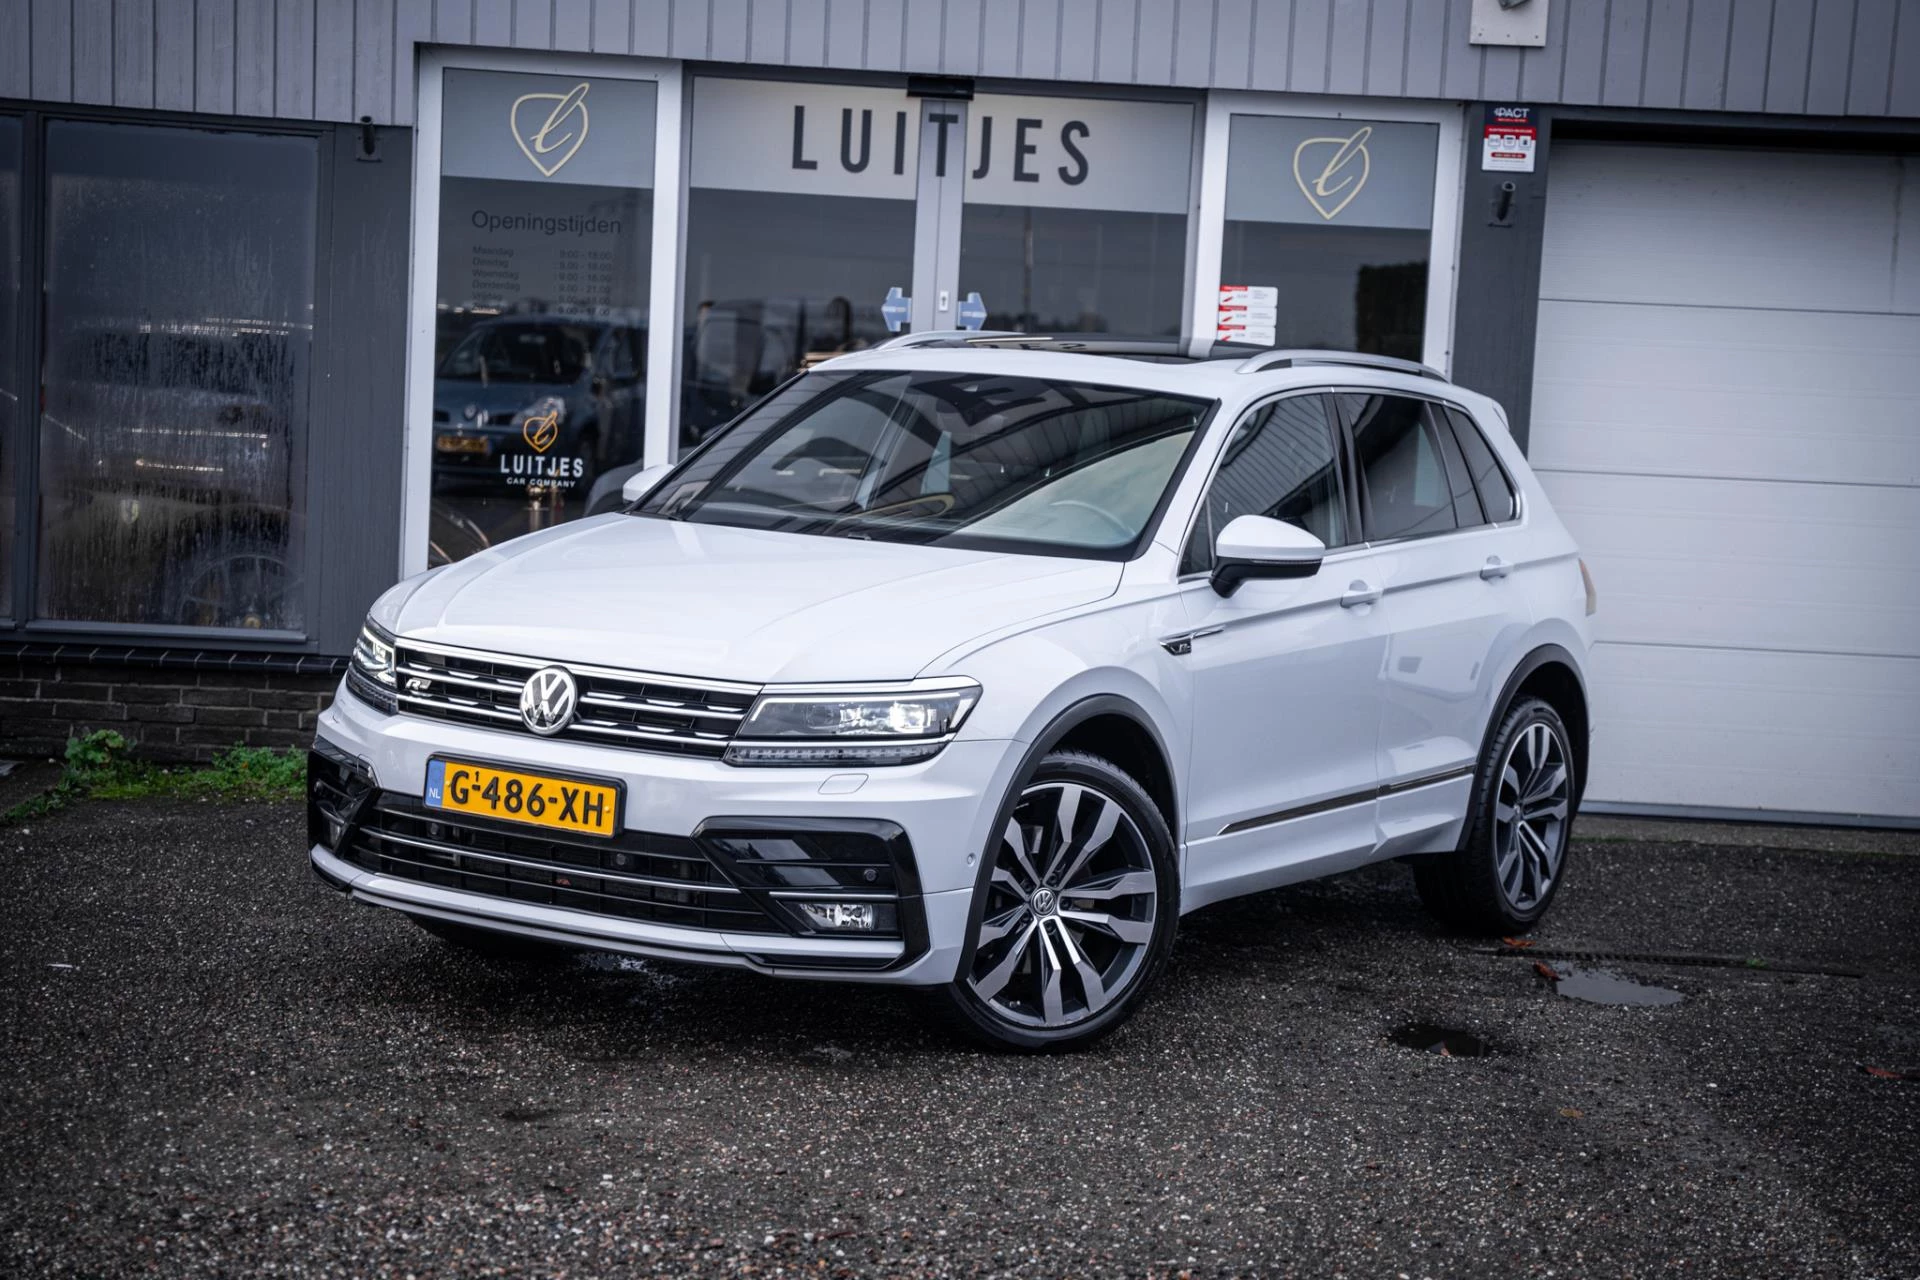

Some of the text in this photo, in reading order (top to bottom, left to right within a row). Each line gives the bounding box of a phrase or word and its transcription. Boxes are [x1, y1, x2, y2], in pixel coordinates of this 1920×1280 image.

[791, 105, 1090, 186] LUITJES
[471, 209, 621, 237] Openingstijden
[500, 454, 584, 478] LUITJES
[506, 477, 576, 488] CAR COMPANY
[428, 787, 441, 800] NL
